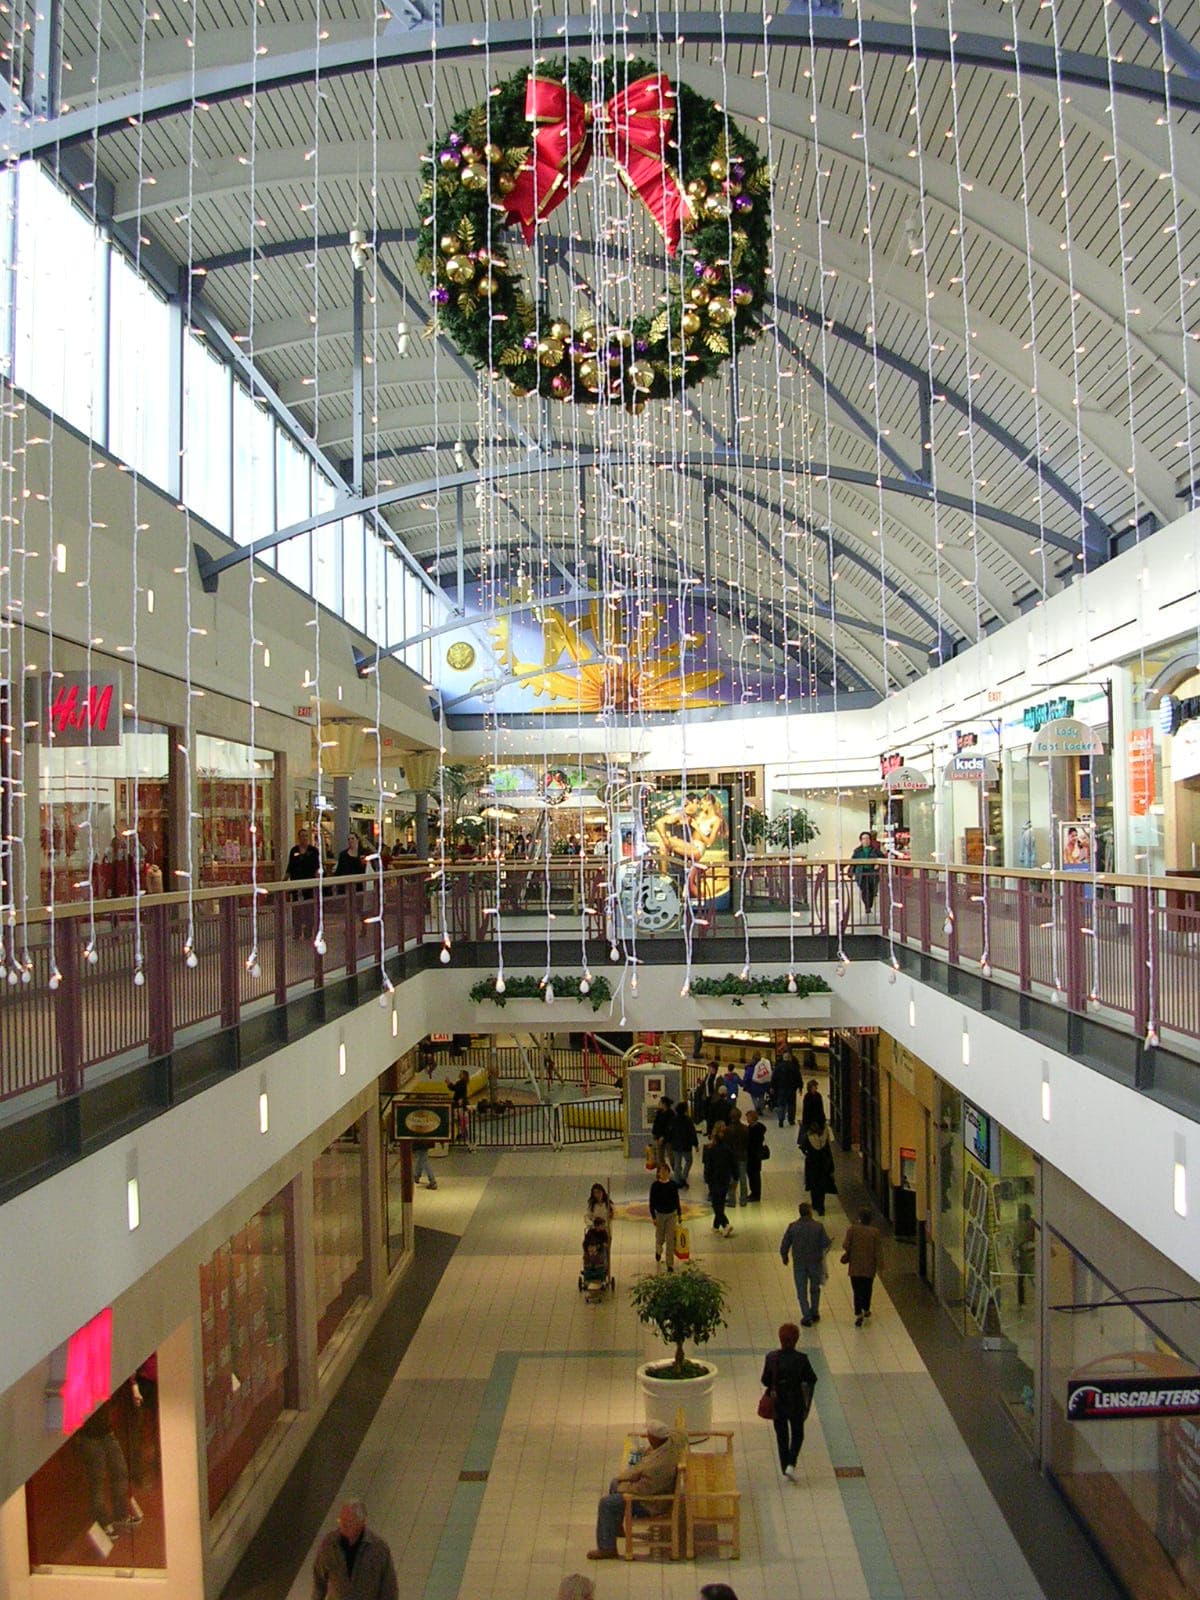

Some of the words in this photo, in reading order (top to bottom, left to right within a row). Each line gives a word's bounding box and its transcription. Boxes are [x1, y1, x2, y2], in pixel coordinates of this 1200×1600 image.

[988, 691, 1001, 702] EXIT
[46, 684, 113, 732] H&M
[1095, 1389, 1200, 1408] LENSCRAFTERS
